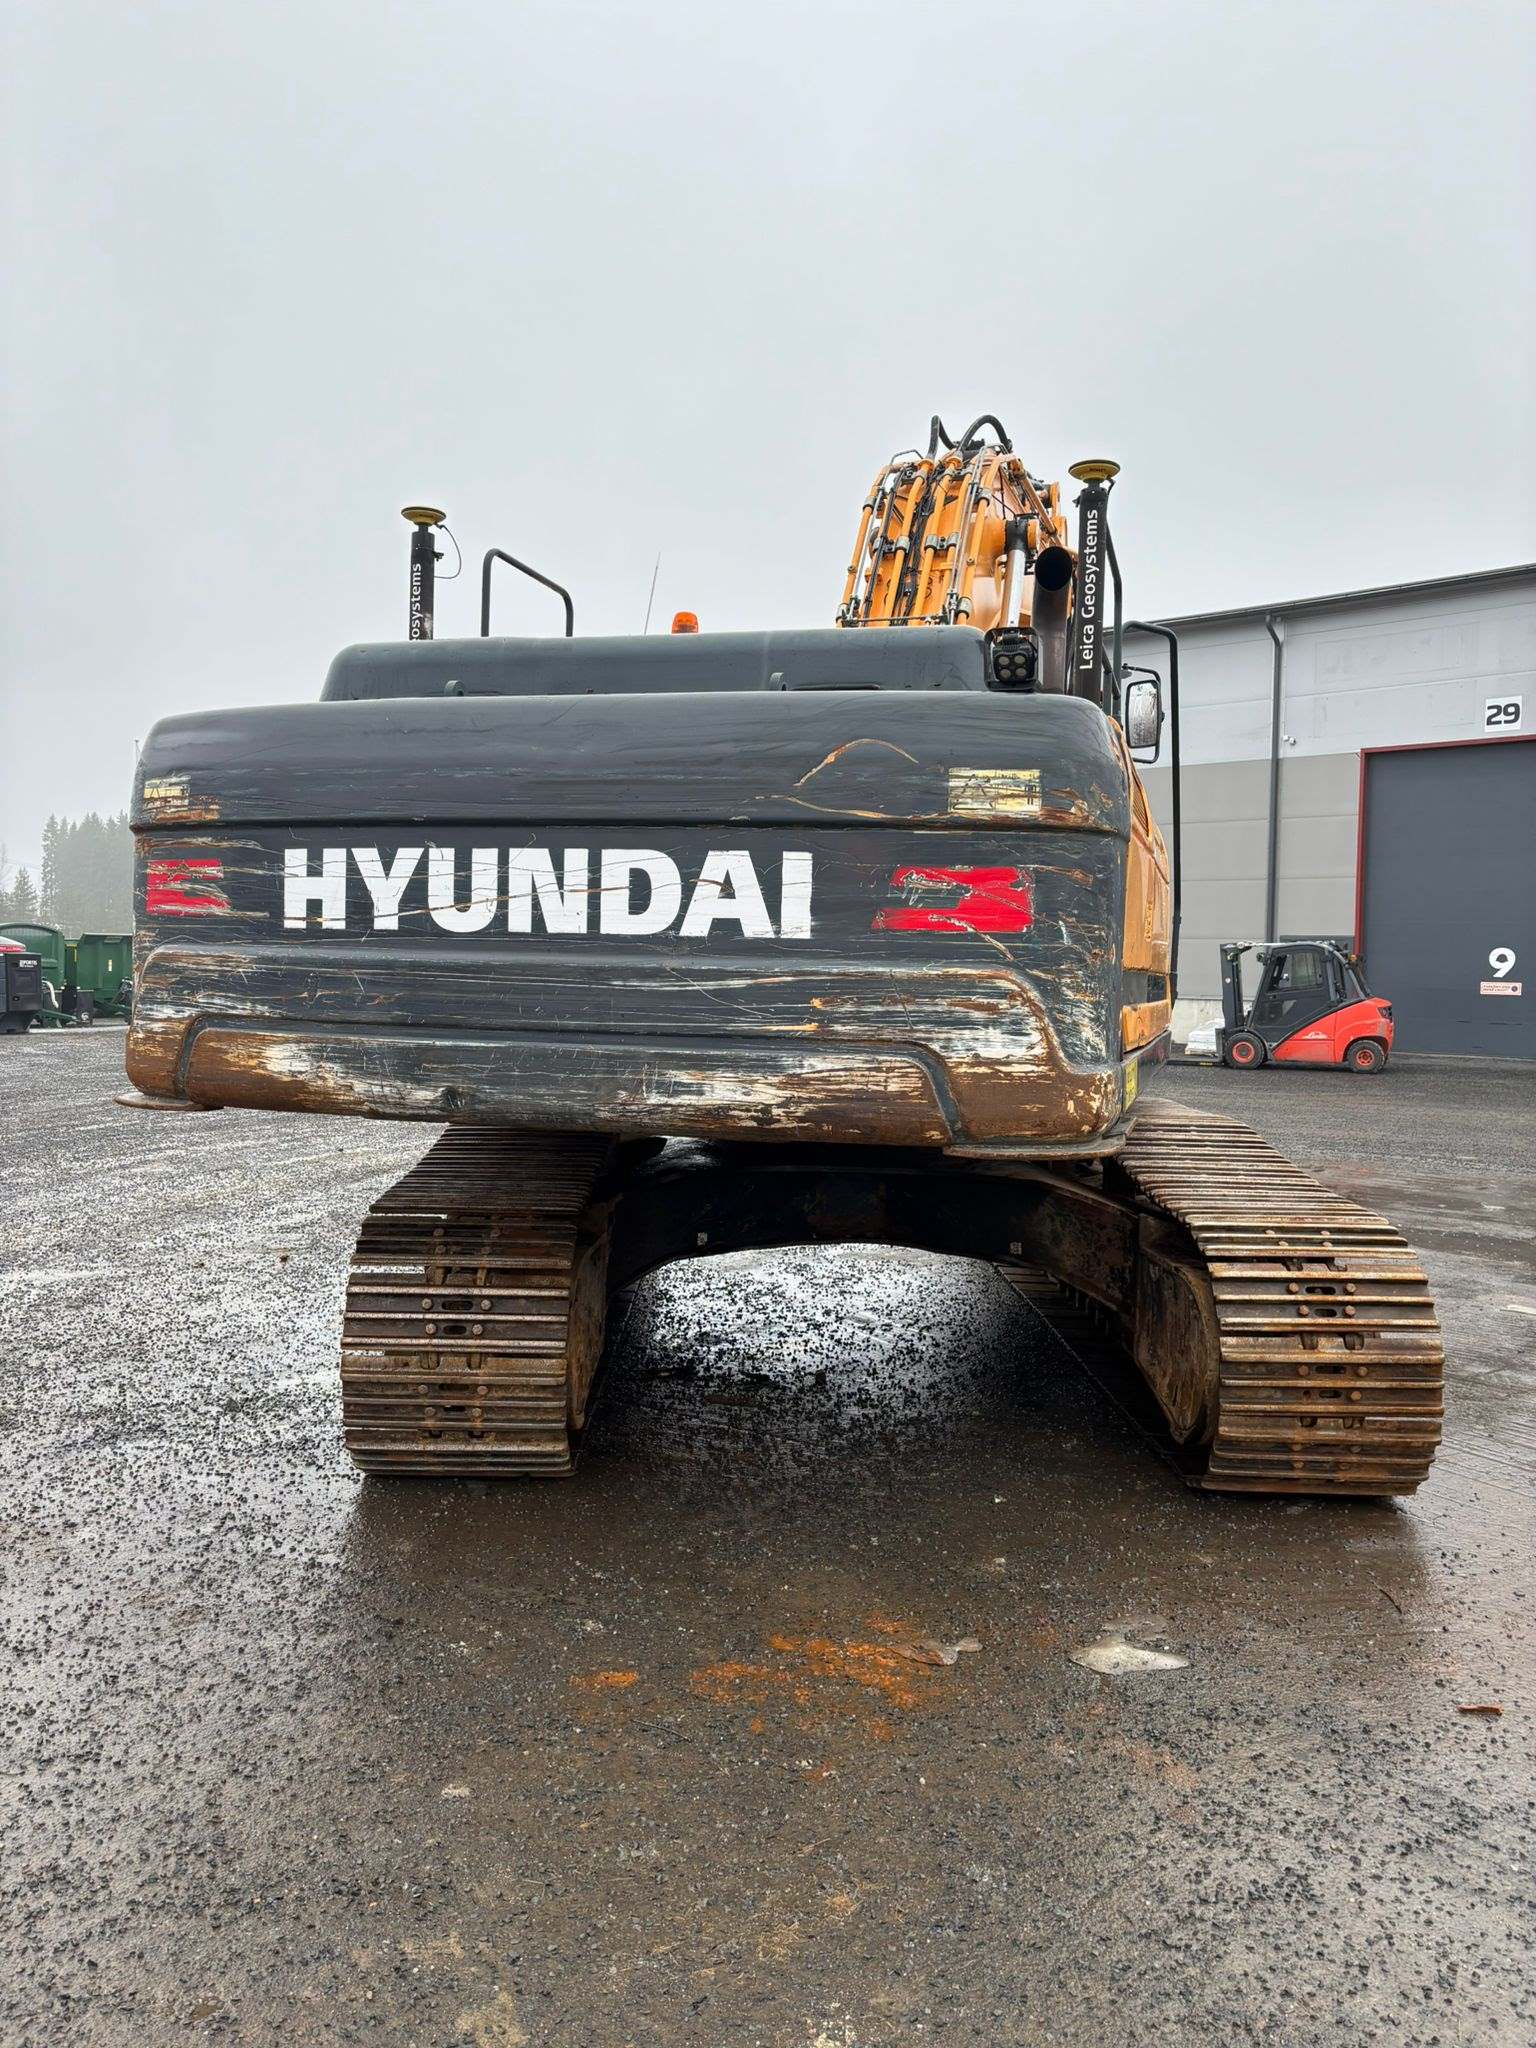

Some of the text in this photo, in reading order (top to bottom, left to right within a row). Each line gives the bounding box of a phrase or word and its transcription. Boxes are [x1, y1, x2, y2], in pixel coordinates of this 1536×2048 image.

[411, 563, 423, 640] osystems
[1080, 509, 1100, 670] Leica Geosystems
[1486, 703, 1520, 725] 29
[283, 847, 813, 939] HYUNDAI
[1489, 947, 1516, 978] 9
